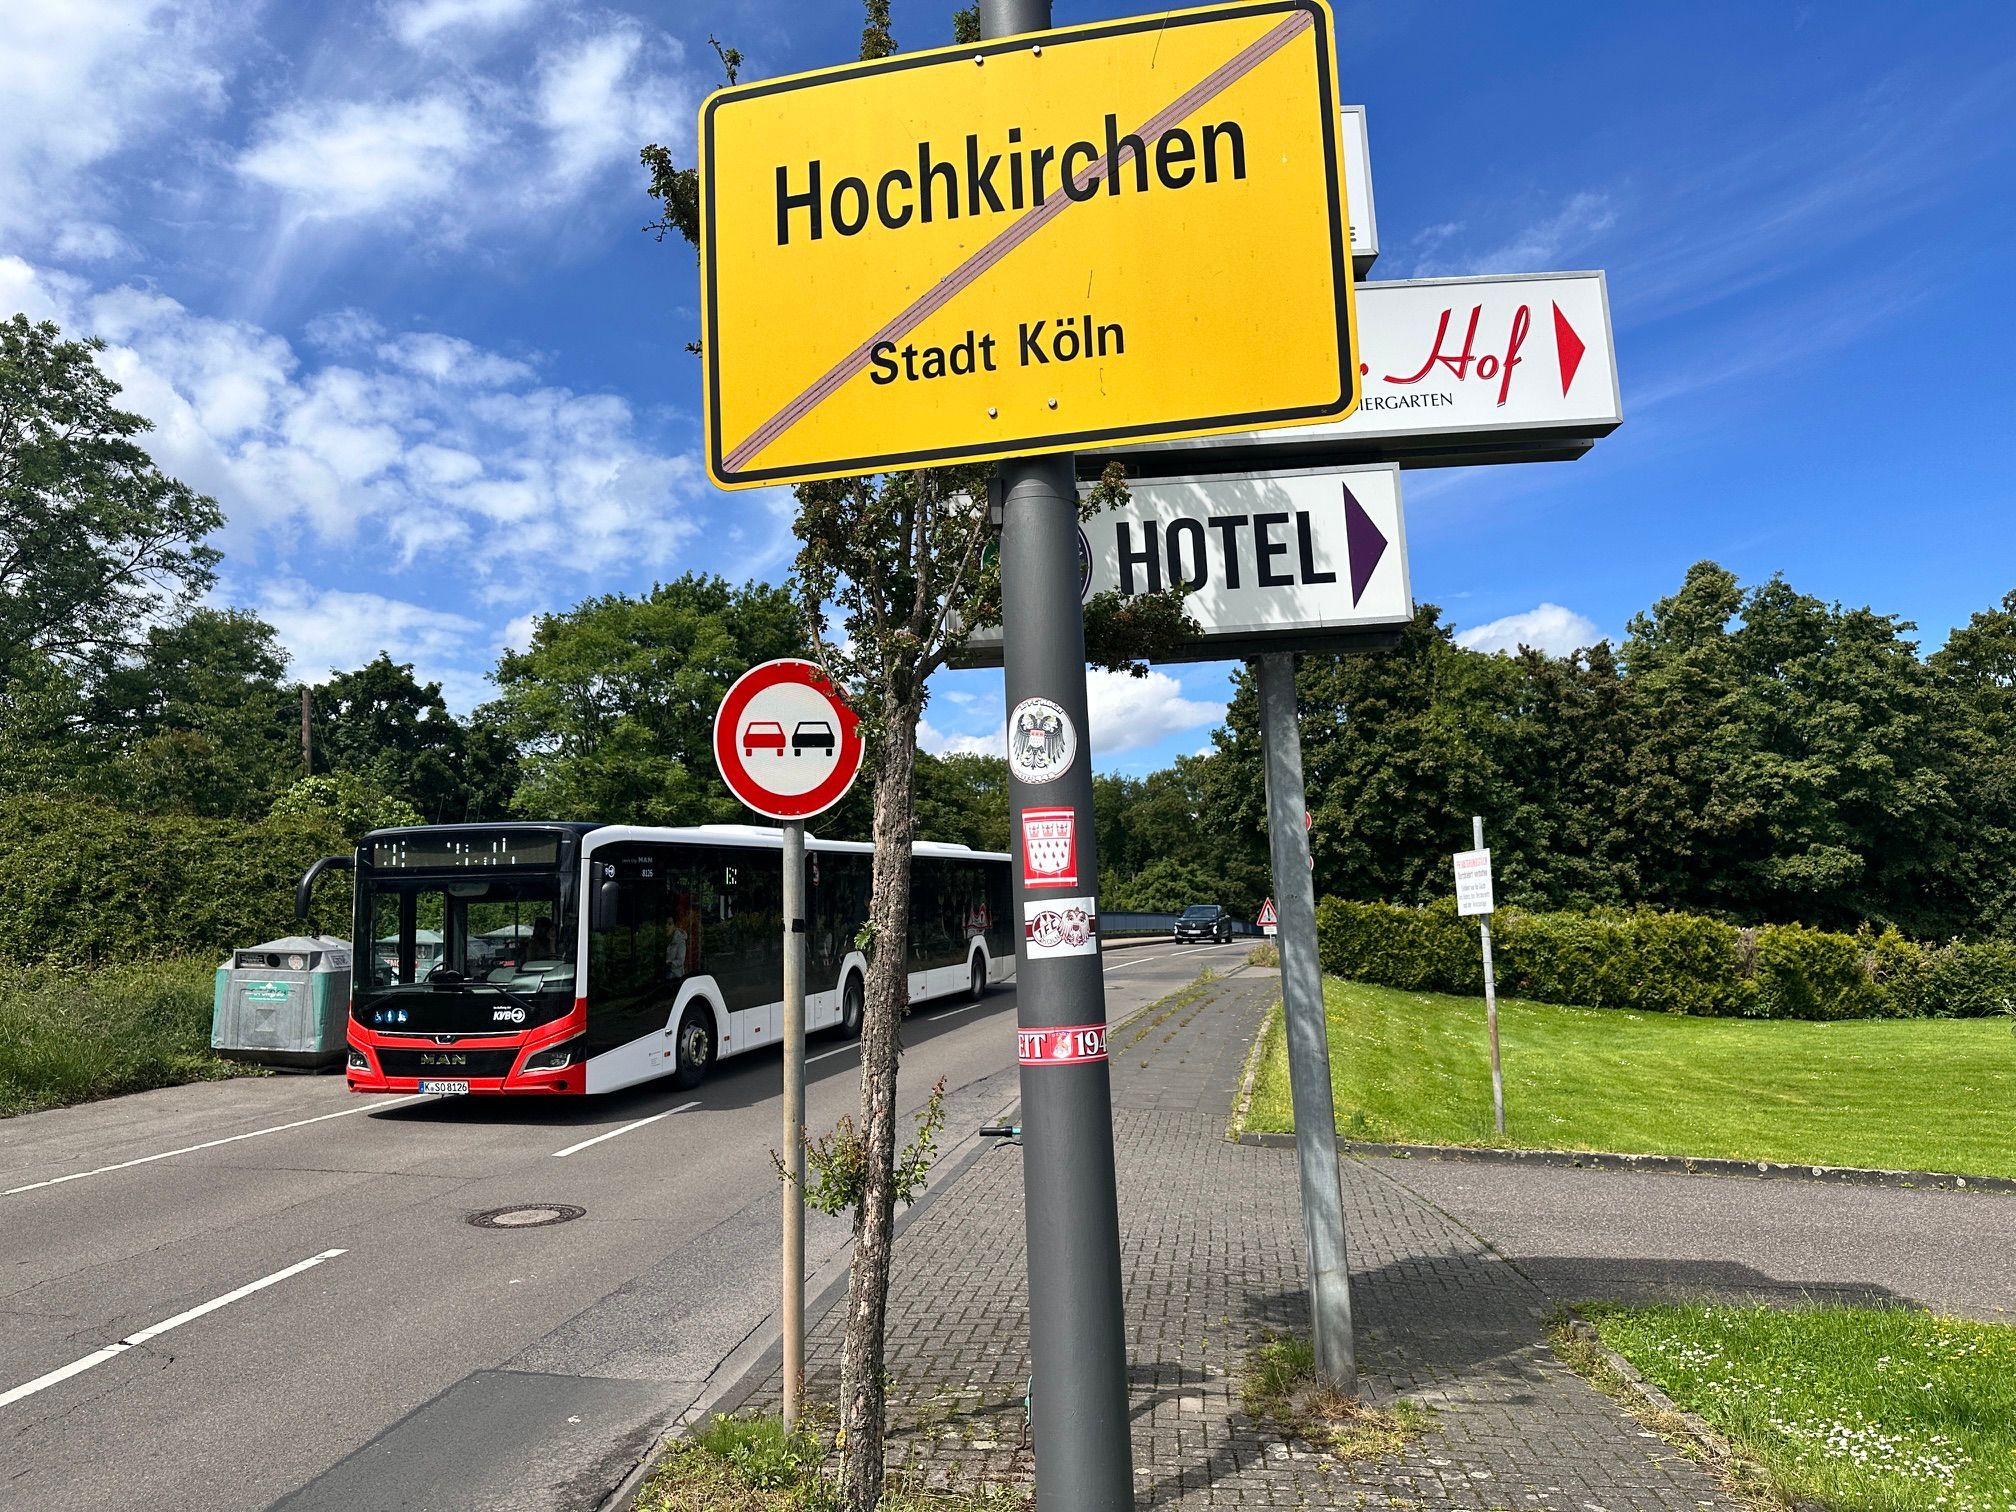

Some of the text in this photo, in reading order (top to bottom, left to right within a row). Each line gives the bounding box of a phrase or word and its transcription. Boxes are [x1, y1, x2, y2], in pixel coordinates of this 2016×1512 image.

[775, 113, 1247, 246] Hochkirchen
[869, 314, 1126, 386] Stadt Köln
[1382, 303, 1531, 408] Hof
[1354, 392, 1454, 412] IERGARTEN
[1115, 510, 1337, 595] HOTEL
[492, 1010, 512, 1021] KVB
[420, 1053, 467, 1065] MAN
[446, 1082, 468, 1092] 8126
